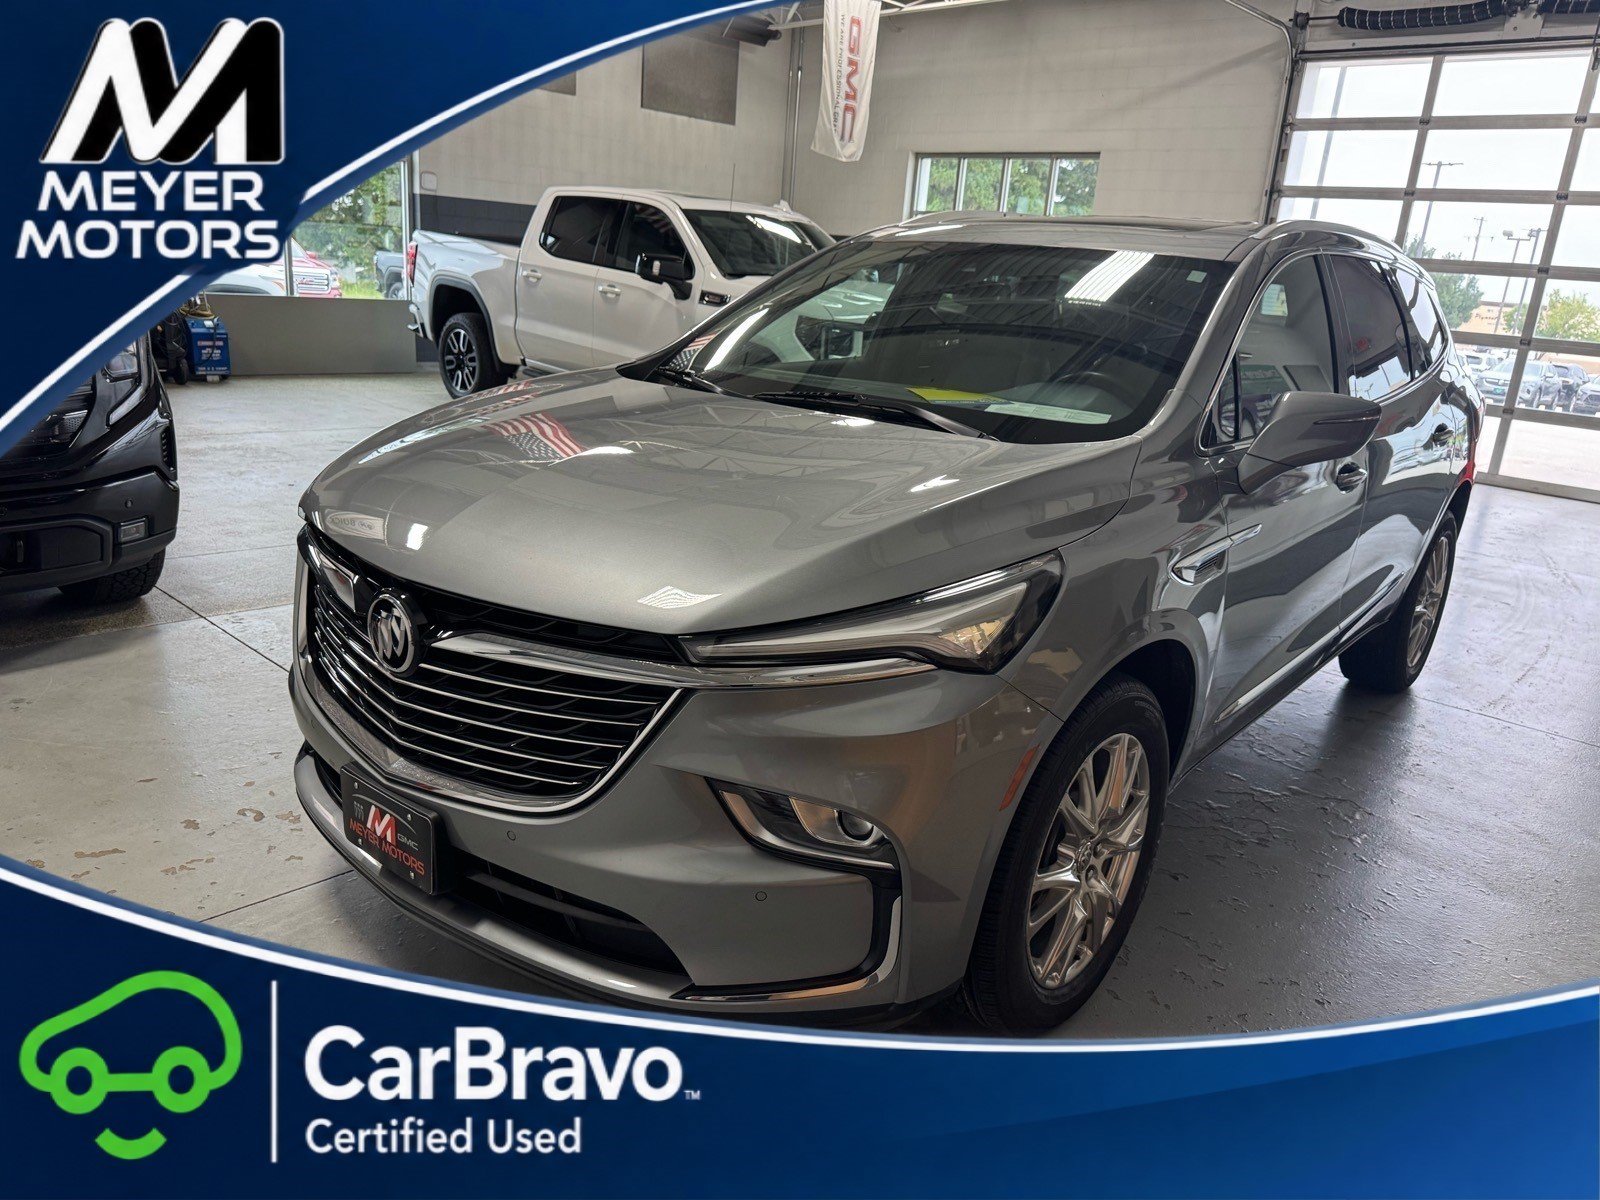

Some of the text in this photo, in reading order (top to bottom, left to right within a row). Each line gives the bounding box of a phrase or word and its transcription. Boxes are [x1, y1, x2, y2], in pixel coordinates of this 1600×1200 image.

[834, 47, 844, 111] PROFESSIONAL
[840, 16, 862, 143] GMC
[349, 818, 425, 876] MEYER MOTORS
[397, 833, 419, 851] GMC
